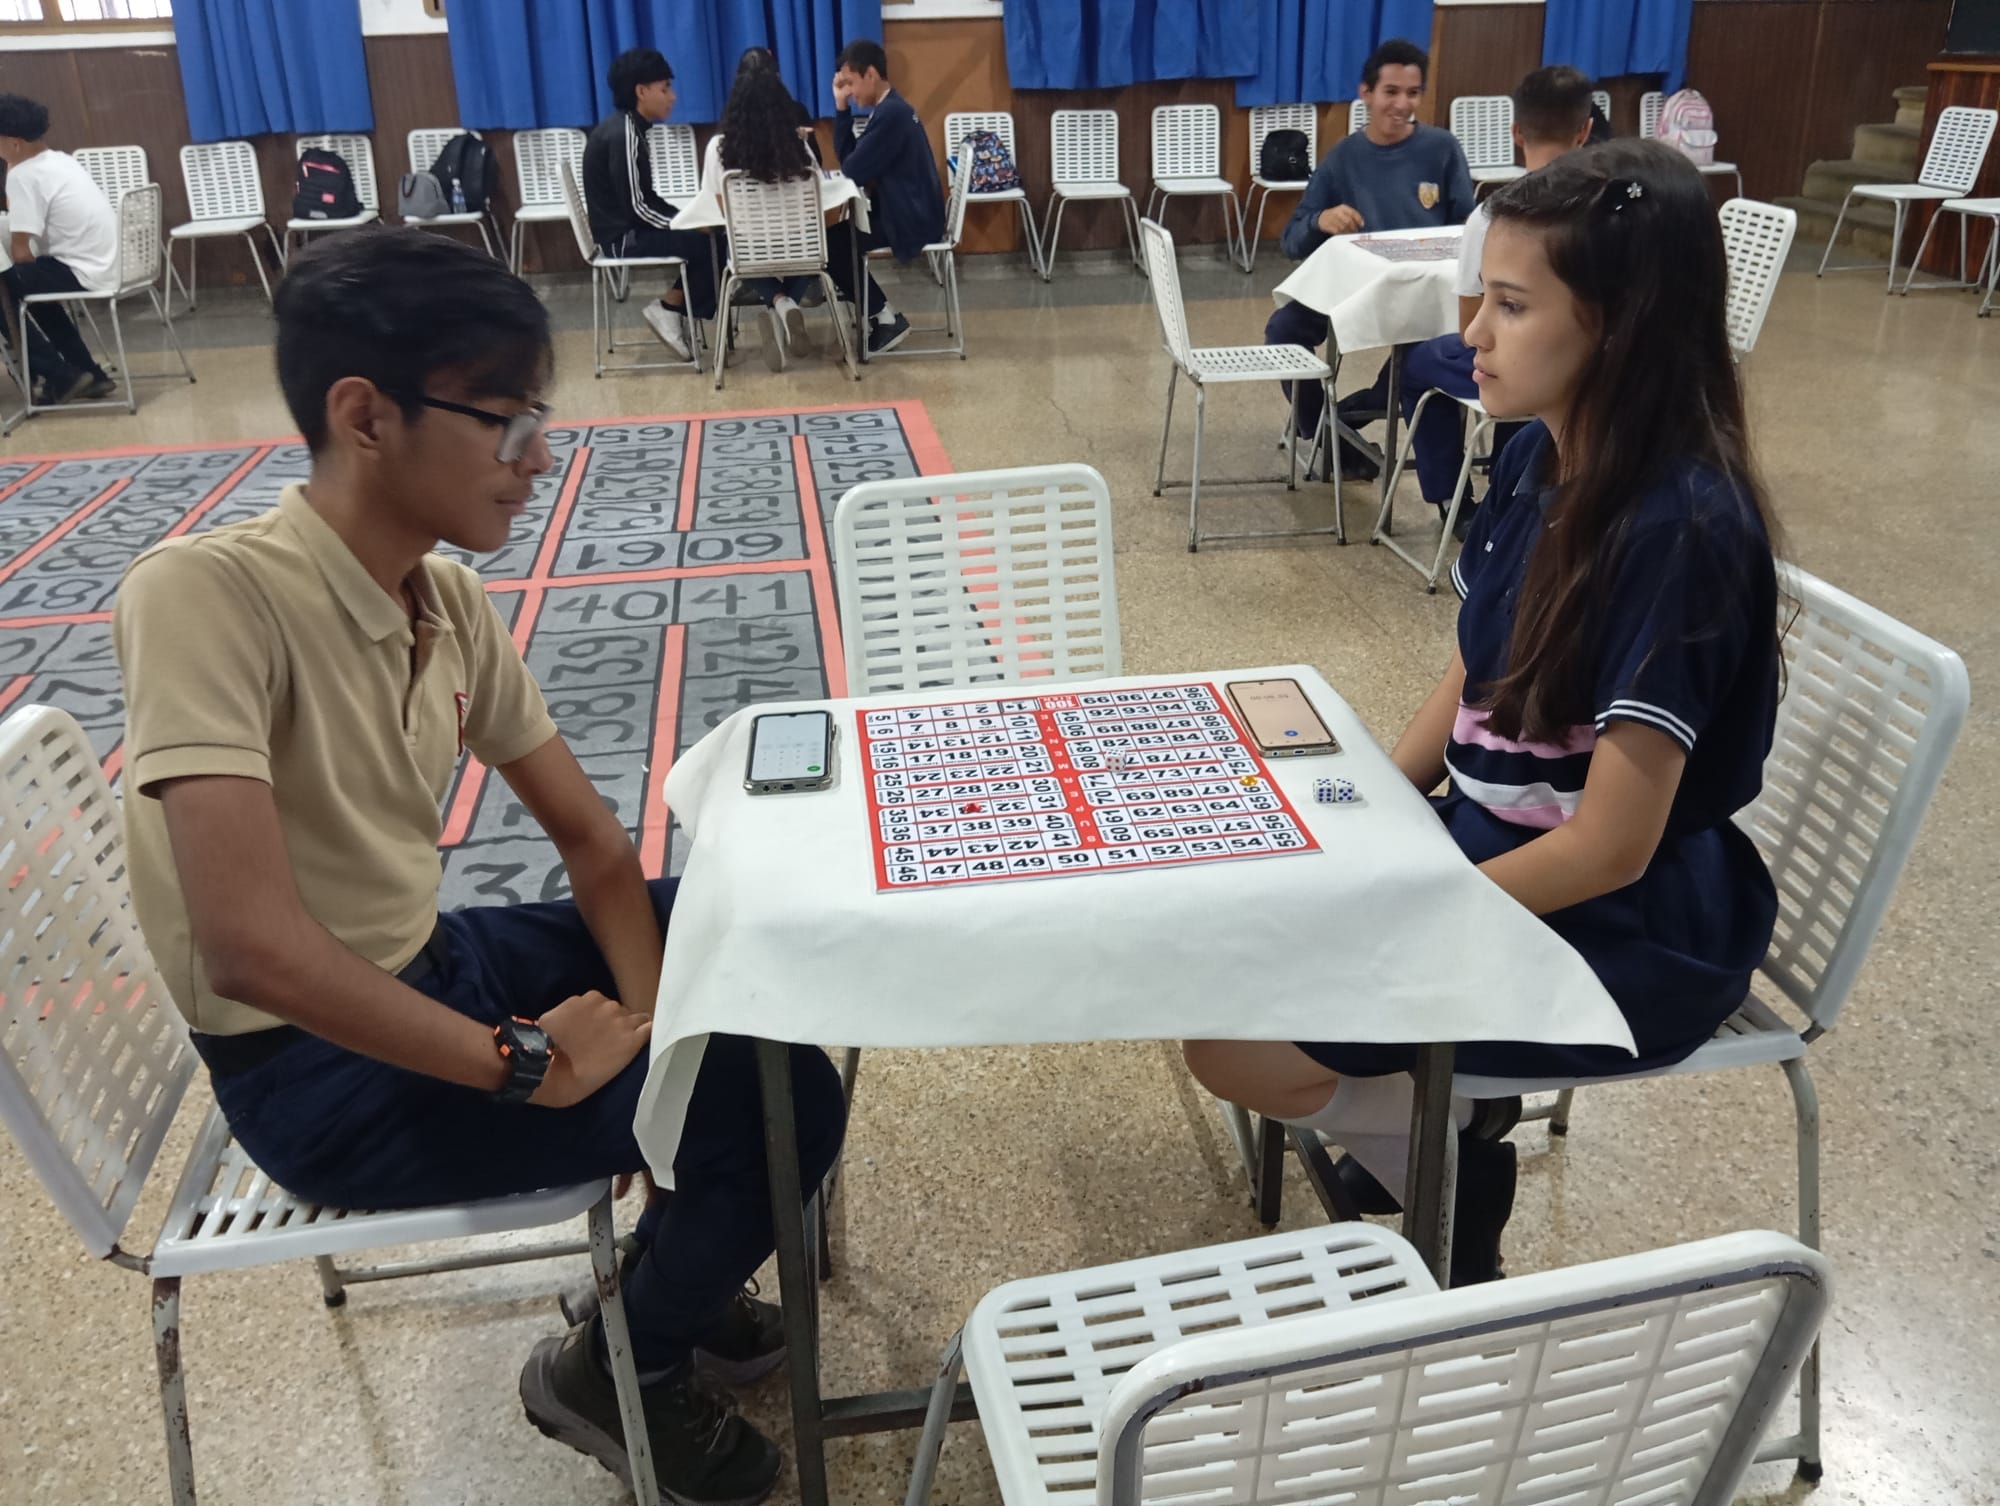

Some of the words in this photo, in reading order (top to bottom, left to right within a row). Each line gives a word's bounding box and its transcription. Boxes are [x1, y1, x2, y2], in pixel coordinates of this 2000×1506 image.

[690, 579, 789, 615] 41
[552, 590, 669, 623] 40
[1231, 837, 1263, 848] 54
[1272, 832, 1296, 847] 55
[1151, 844, 1183, 856] 52
[1191, 841, 1224, 852] 53
[1057, 853, 1090, 864] 50
[1108, 848, 1137, 859] 51
[972, 860, 1004, 872] 48
[1013, 857, 1045, 868] 49
[898, 866, 918, 882] 46
[930, 864, 962, 875] 47
